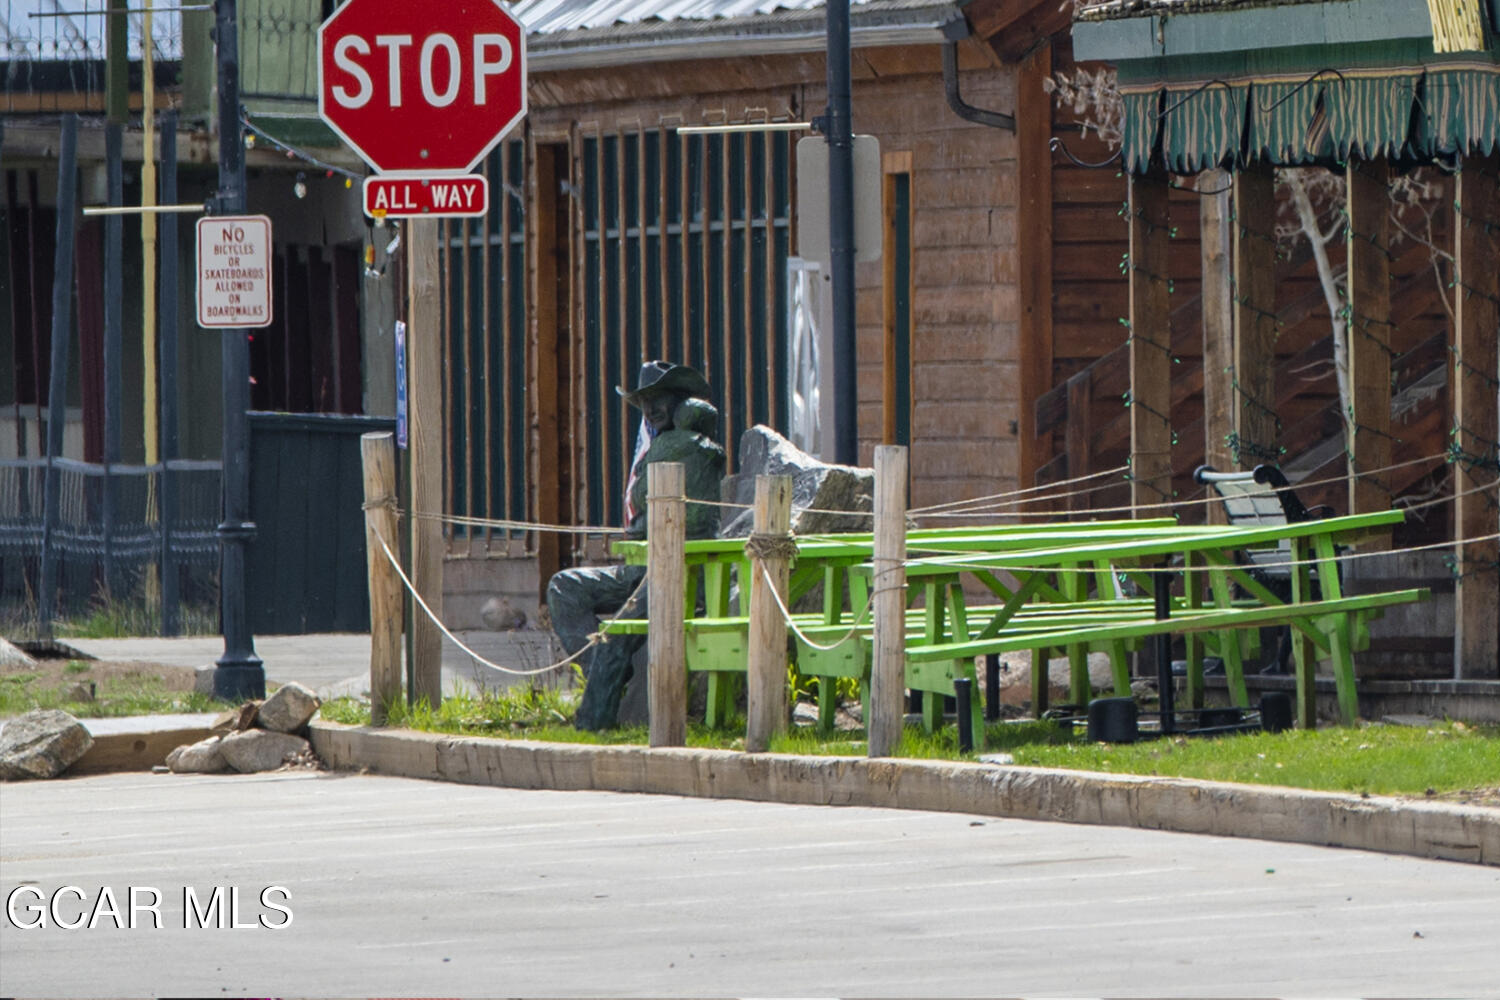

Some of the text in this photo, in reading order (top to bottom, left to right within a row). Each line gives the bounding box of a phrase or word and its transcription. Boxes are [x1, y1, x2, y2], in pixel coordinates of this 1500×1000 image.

[332, 33, 512, 109] STOP
[375, 184, 477, 209] ALL WAY
[222, 227, 245, 242] NO
[213, 244, 254, 255] BICYCLES
[228, 257, 240, 267] OR
[205, 268, 264, 280] SKATEBOARDS
[215, 282, 254, 292] ALLOWED
[228, 294, 240, 304] ON
[206, 305, 263, 317] BOARDWALKS
